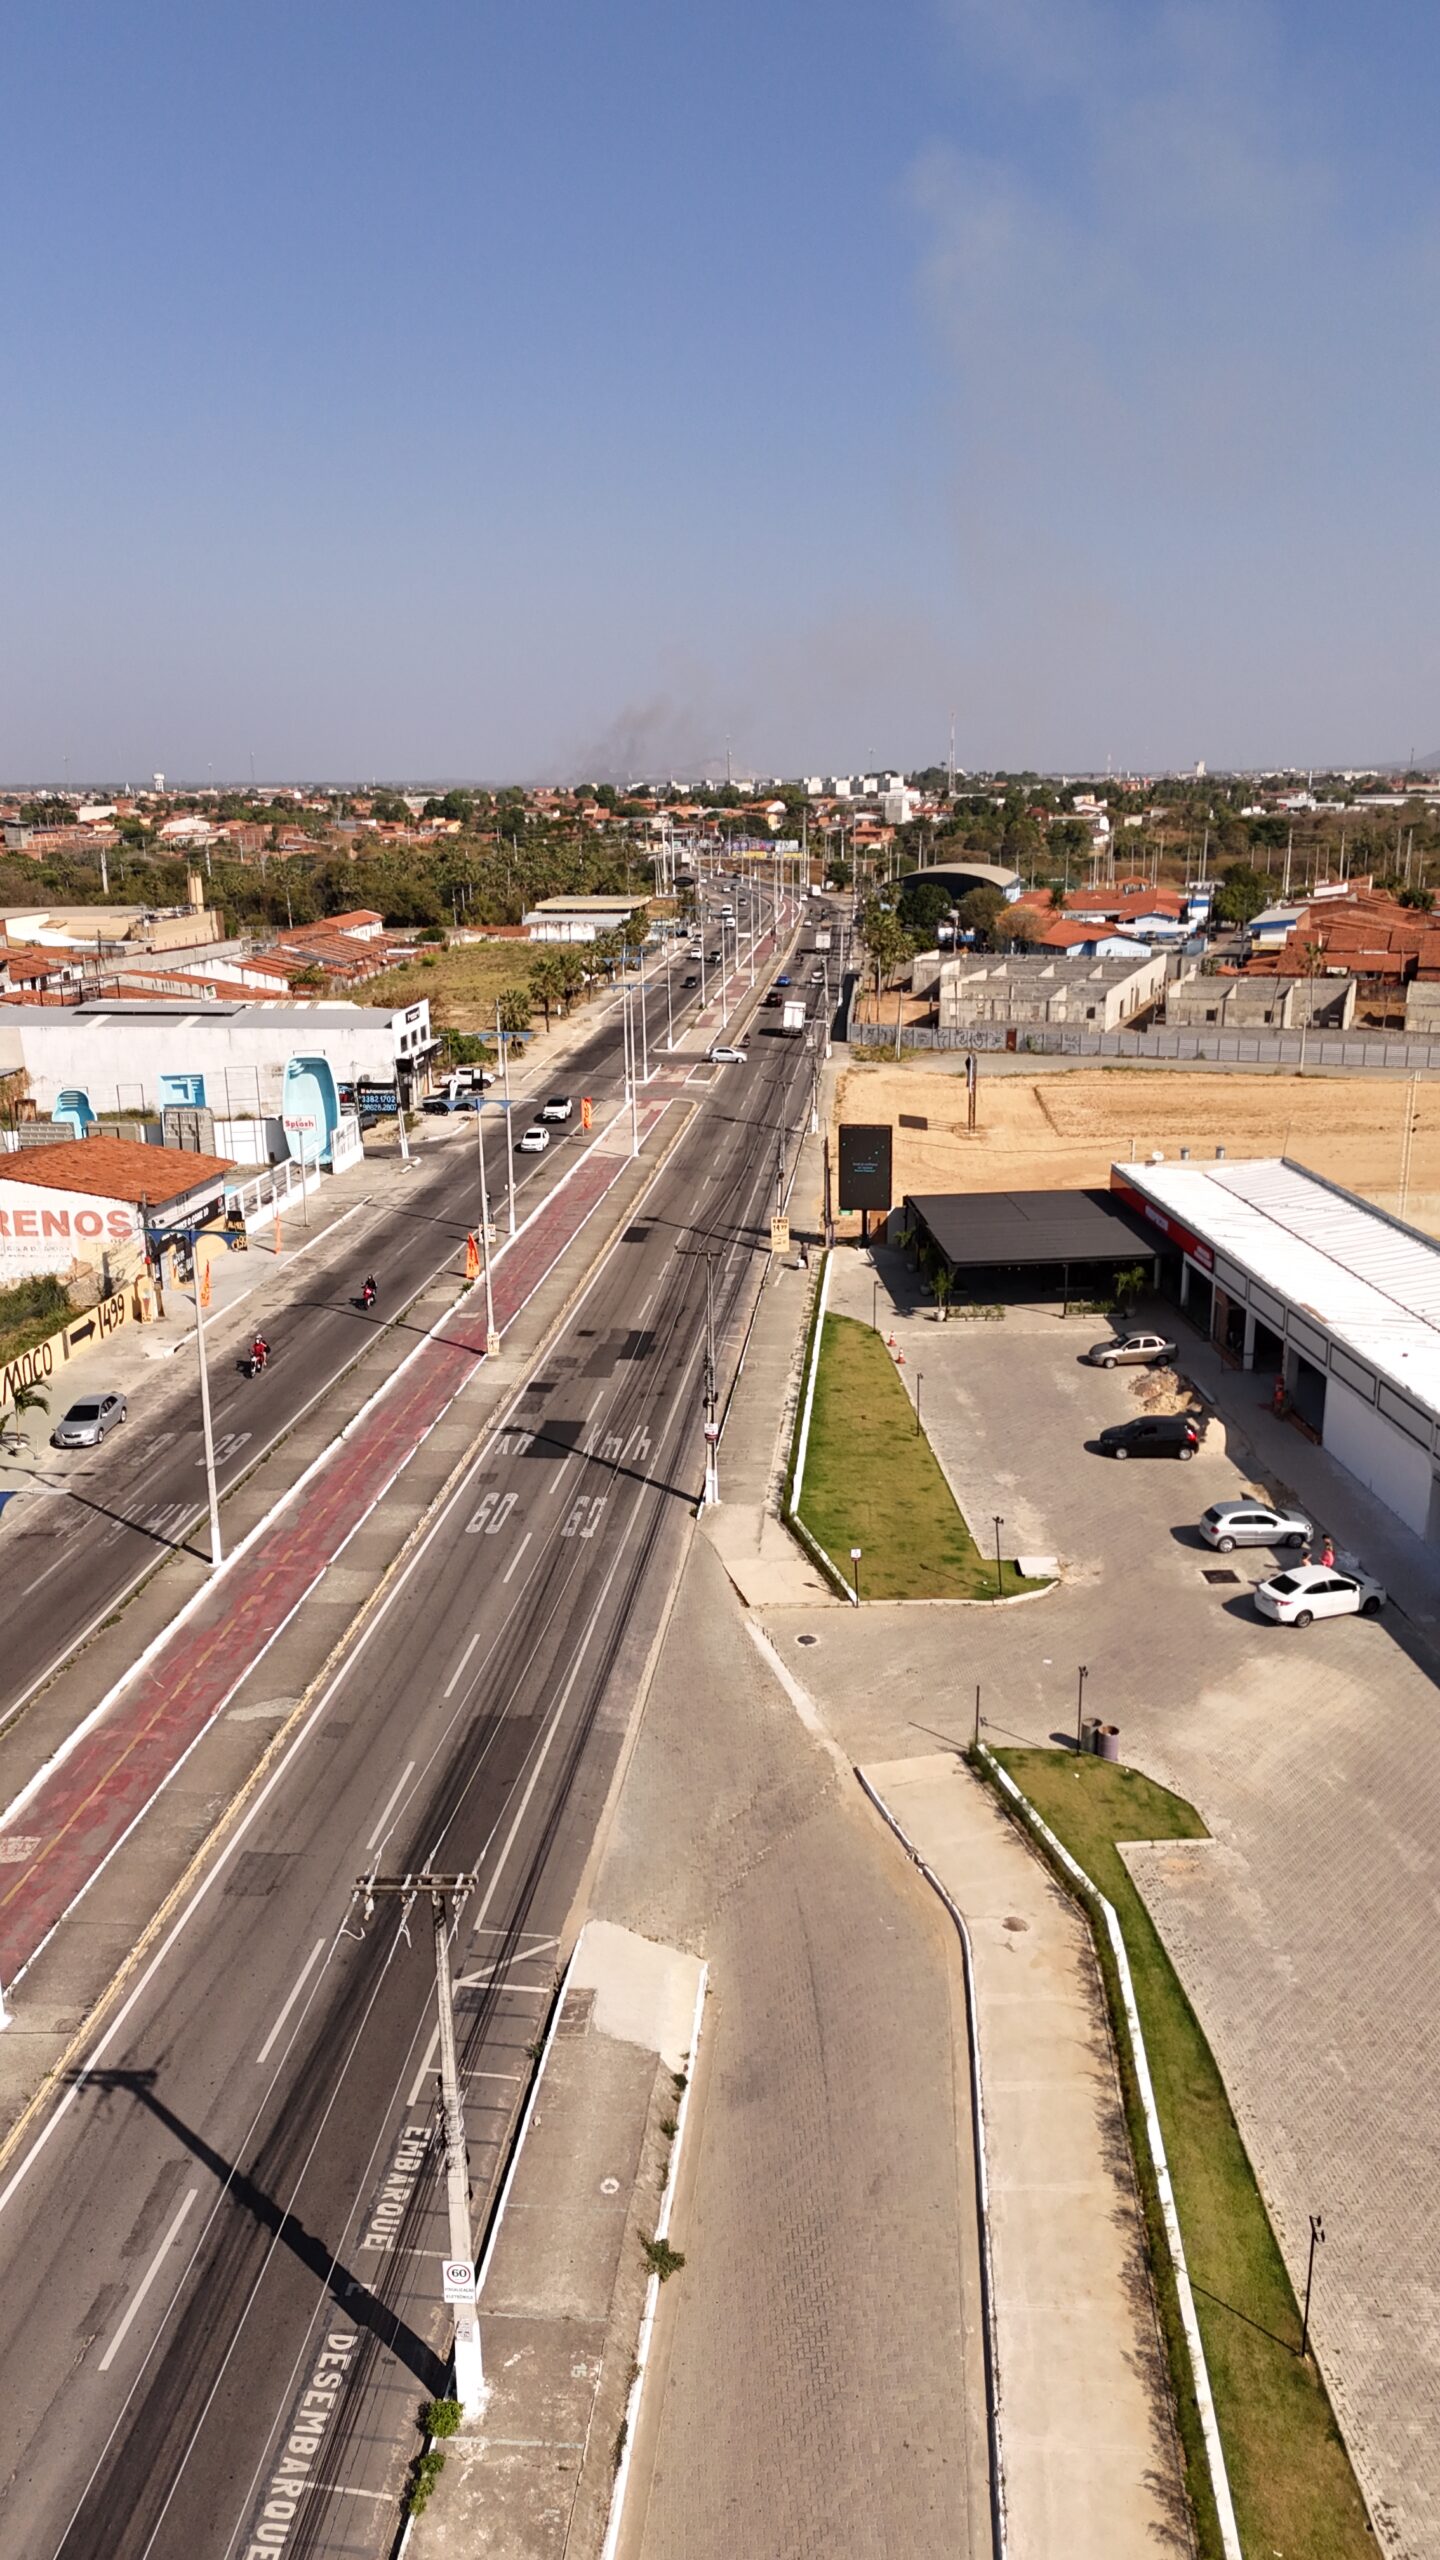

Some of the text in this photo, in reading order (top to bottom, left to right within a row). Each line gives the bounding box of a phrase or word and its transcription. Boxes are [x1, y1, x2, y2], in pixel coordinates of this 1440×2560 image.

[285, 1120, 314, 1129] Splash
[465, 1492, 519, 1534] 60
[560, 1496, 608, 1537] 60
[363, 2126, 431, 2251] EMBARQUE
[451, 2269, 468, 2278] 60
